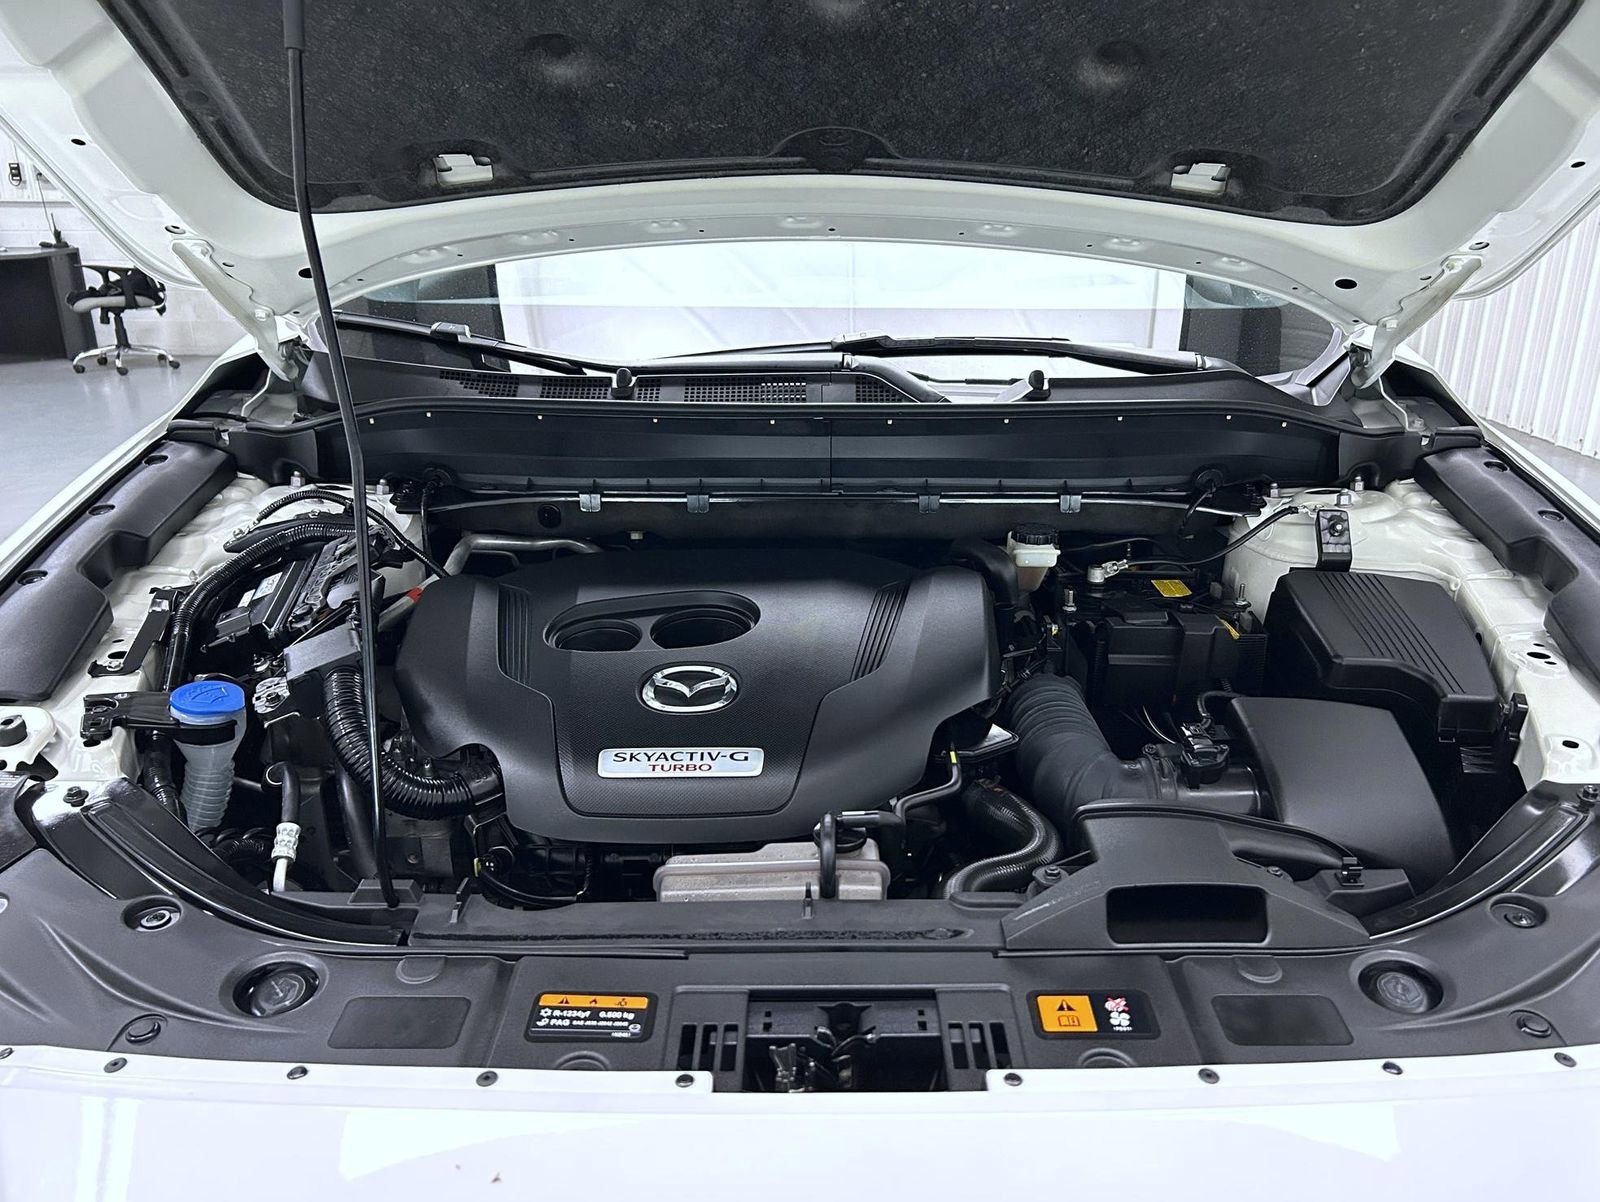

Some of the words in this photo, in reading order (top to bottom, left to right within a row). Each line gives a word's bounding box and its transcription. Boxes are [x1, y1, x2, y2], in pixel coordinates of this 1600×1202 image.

[613, 751, 749, 763] SKYACTIV-G
[648, 763, 712, 772] TURBO
[550, 1018, 570, 1027] PAG
